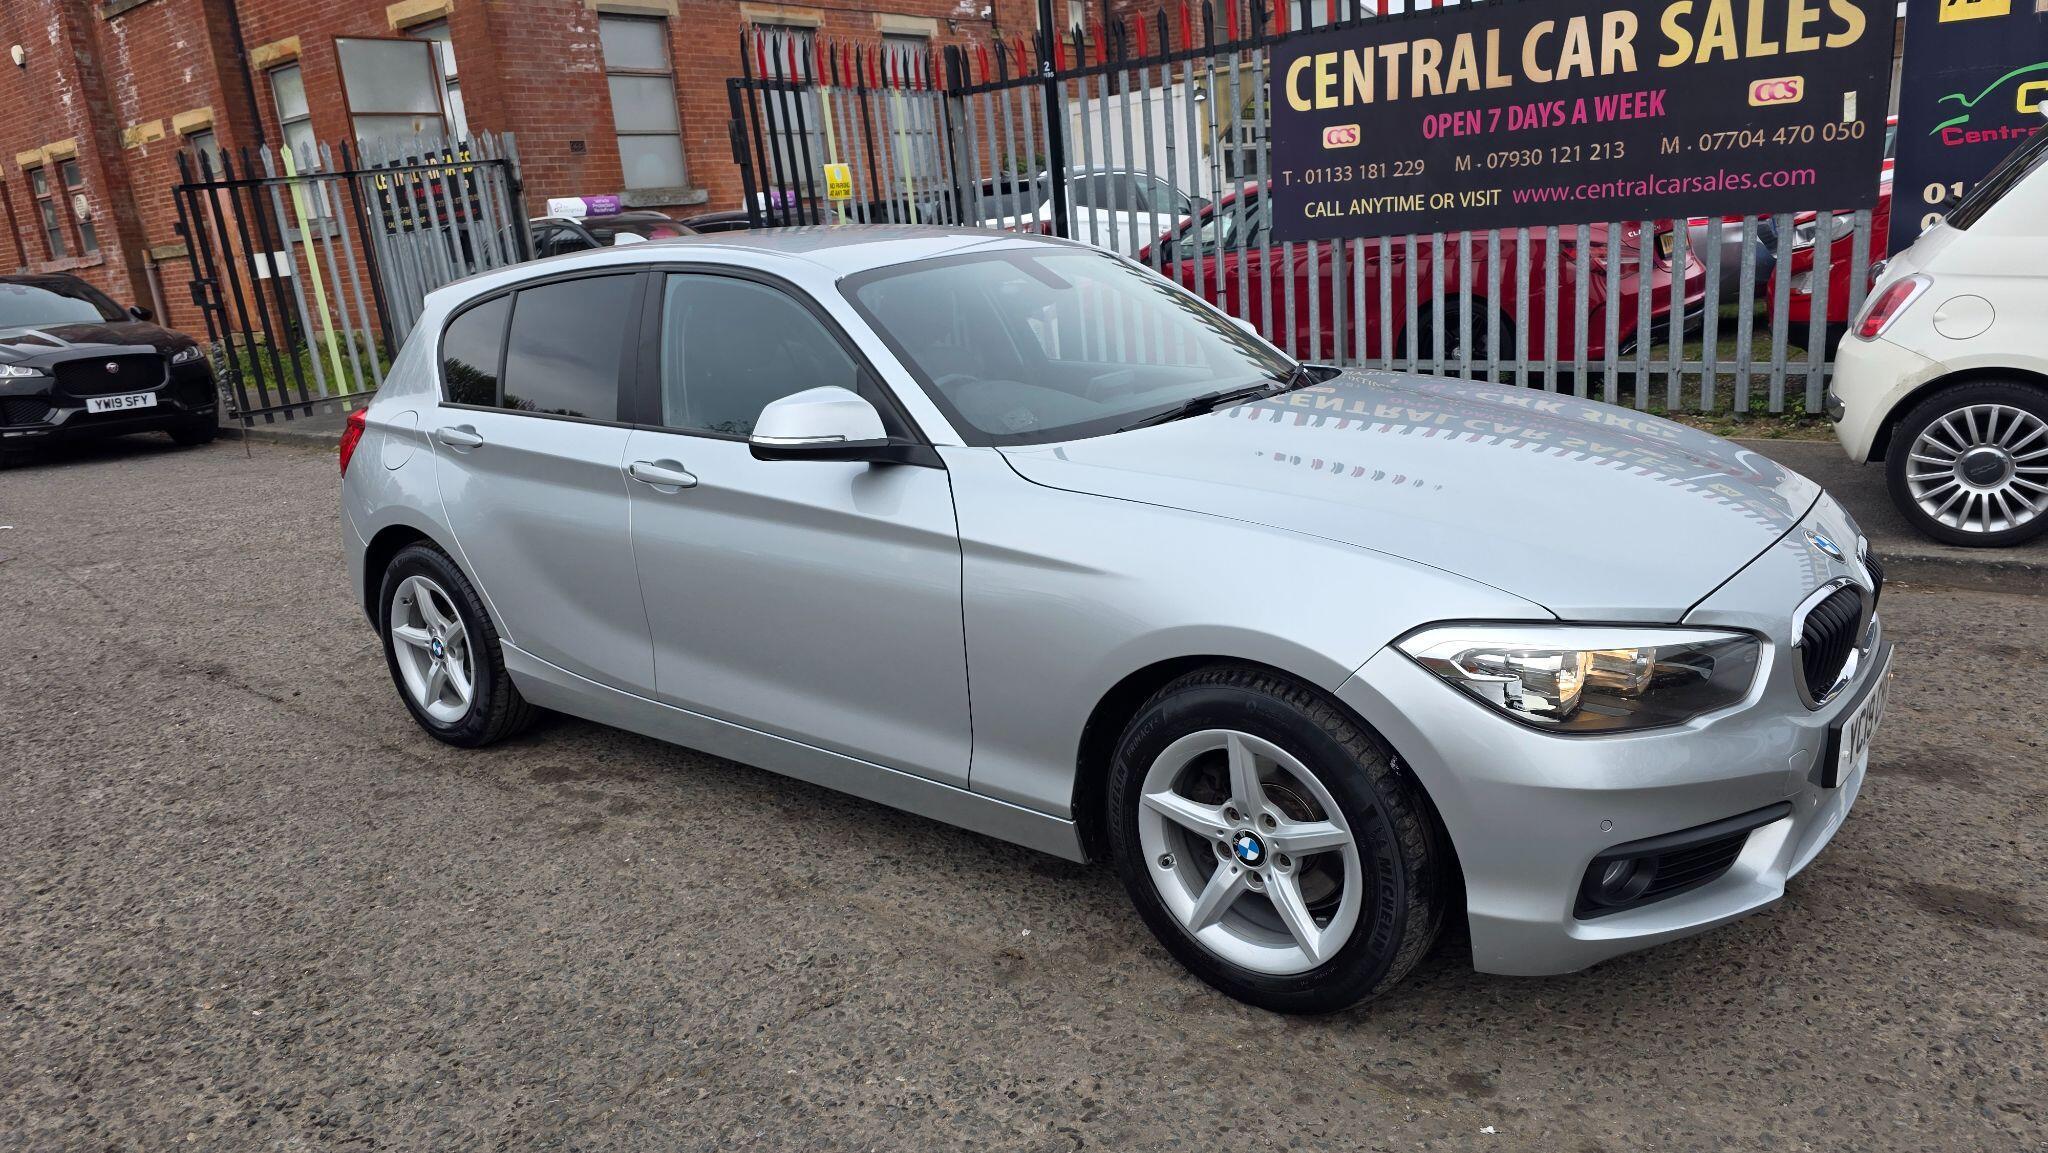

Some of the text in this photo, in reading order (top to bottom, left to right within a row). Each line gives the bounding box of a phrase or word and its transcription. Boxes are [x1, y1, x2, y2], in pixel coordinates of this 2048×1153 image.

[1285, 0, 1867, 112] CENTRAL CAR SALES
[1422, 89, 1667, 139] OPEN 7 DAYS A WEEK
[1486, 147, 1543, 169] 07930
[1550, 145, 1581, 164] 121
[1589, 141, 1625, 161] 213
[1699, 129, 1766, 152] 07704
[1773, 124, 1815, 146] 470
[1822, 120, 1866, 142] 050
[1305, 164, 1354, 185] 01133
[1359, 162, 1386, 181] 181
[1393, 159, 1425, 178] 229
[1305, 168, 1817, 219] CALL ANYTIME OR VISIT www.centralcarsales.com
[95, 395, 148, 410] YW19 SFY
[1375, 856, 1396, 957] MICHELIN
